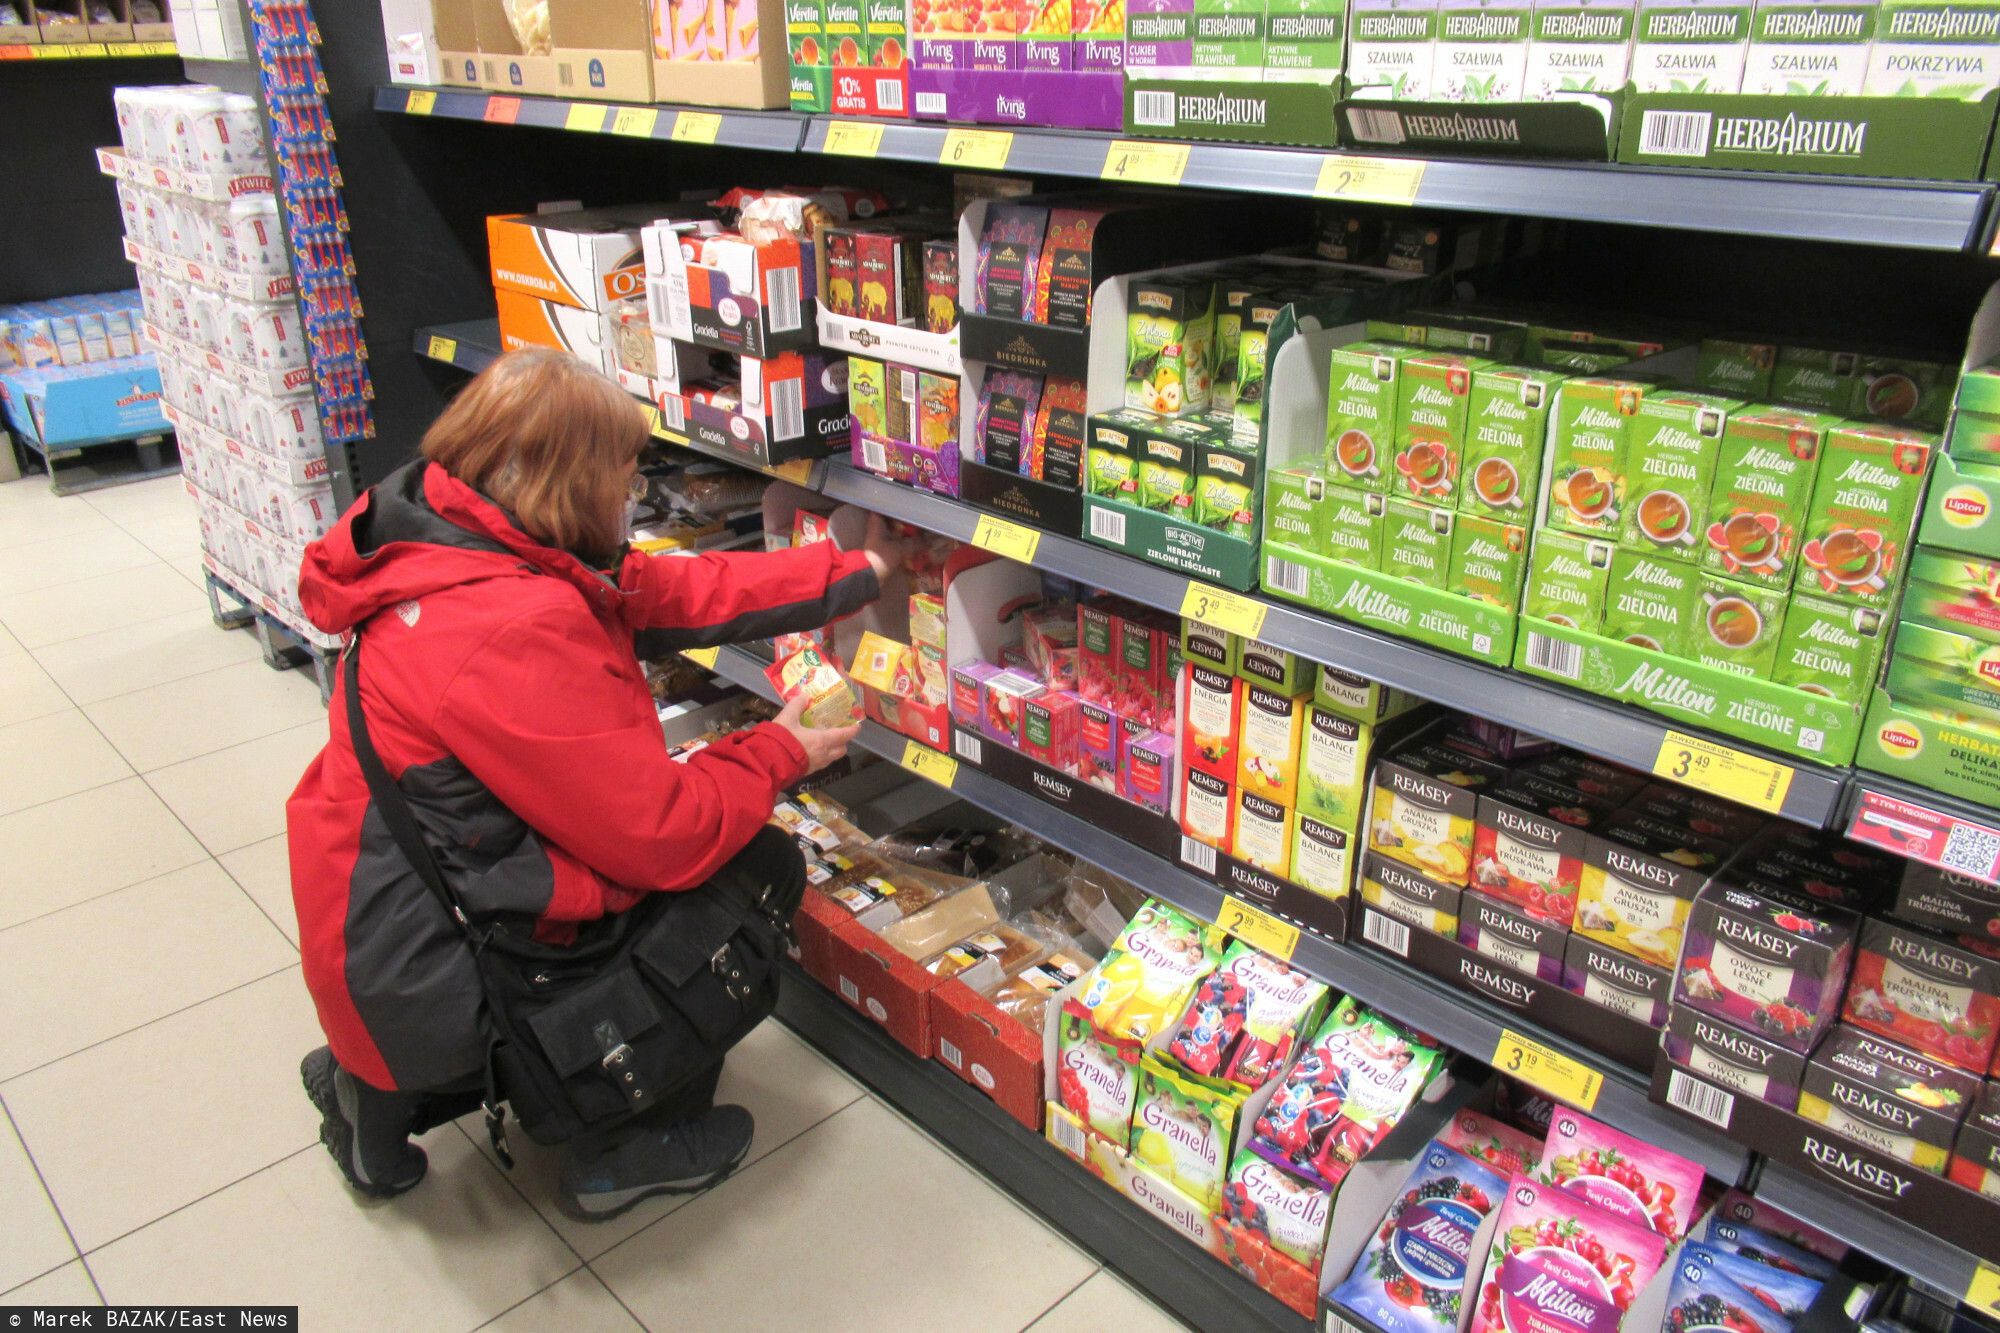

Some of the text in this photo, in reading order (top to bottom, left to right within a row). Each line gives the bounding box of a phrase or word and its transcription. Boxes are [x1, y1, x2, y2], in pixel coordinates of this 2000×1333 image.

[789, 7, 818, 22] Verdin
[827, 6, 858, 22] Verdin
[870, 5, 903, 22] Verdin
[1542, 11, 1622, 38] HERBARIUM
[1648, 11, 1737, 37] HERBARIUM
[1763, 9, 1863, 37] HERBARIUM
[1132, 15, 1185, 37] HERBARIUM
[1199, 14, 1255, 37] HERBARIUM
[1273, 14, 1333, 38] HERBARIUM
[1360, 14, 1426, 38] HERBARIUM
[1446, 12, 1519, 38] HERBARIUM
[1130, 46, 1156, 55] CUKIER
[1196, 55, 1235, 65] TRAWIENIE
[1268, 46, 1298, 55] AKTYWNE
[1268, 56, 1312, 67] TRAWIENIE
[1368, 51, 1413, 64] SZAŁWIA
[1453, 52, 1503, 66] SZAŁWIA
[1550, 52, 1603, 67] SZAŁWIA
[1656, 54, 1716, 69] SZAŁWIA
[1771, 55, 1838, 71] SZAŁWIA
[1887, 55, 1983, 73] POKRZYWA
[791, 78, 813, 92] Verdin
[839, 77, 860, 94] 10%
[837, 98, 866, 109] GRATIS
[1179, 92, 1266, 125] HERBARIUM
[1406, 113, 1519, 141] HERBARIUM
[1715, 112, 1867, 155] HERBARIUM
[1115, 154, 1127, 176] 4
[1335, 172, 1351, 194] 2
[997, 351, 1047, 368] BIEDRONKA
[1338, 401, 1377, 419] ZIELONA
[1411, 410, 1447, 427] ZIELONA
[1572, 406, 1622, 431] Milton
[1478, 426, 1523, 448] ZIELONA
[1572, 434, 1615, 451] ZIELONA
[1643, 457, 1697, 481] ZIELONA
[1735, 445, 1796, 475] Milton
[1834, 458, 1901, 490] Milton
[1734, 475, 1784, 497] ZIELONA
[994, 497, 1040, 518] BIEDRONKA
[1834, 490, 1889, 513] ZIELONA
[1948, 499, 1983, 514] Lipton
[1274, 516, 1310, 535] ZIELONA
[984, 532, 991, 547] 1
[1331, 531, 1369, 550] ZIELONA
[1148, 549, 1221, 578] ZIELONE LIŚCIASTE
[1166, 545, 1201, 561] HERBATY
[1393, 548, 1434, 570] ZIELONA
[1465, 563, 1501, 582] ZIELONA
[1624, 560, 1683, 591] Milton
[1335, 580, 1411, 625] Milton
[1540, 582, 1587, 606] ZIELONA
[1084, 610, 1109, 624] REMSEY
[1195, 597, 1220, 617] 3 49
[1617, 594, 1678, 624] ZIELONA
[1123, 623, 1149, 638] REMSEY
[1419, 612, 1469, 640] ZIELONE
[1799, 619, 1861, 649] Milton
[1191, 640, 1222, 659] REMSEY
[1248, 659, 1280, 678] REMSEY
[1791, 649, 1852, 678] ZIELONA
[1195, 670, 1228, 693] REMSEY
[1615, 662, 1717, 715] Milton
[1194, 689, 1227, 706] ENERGIA
[1252, 691, 1288, 712] REMSEY
[1325, 682, 1366, 704] BALANCE
[1026, 703, 1050, 719] REMSEY
[1083, 706, 1109, 722] REMSEY
[1249, 709, 1289, 729] ODPORNOŚĆ
[1726, 701, 1795, 735] ZIELONE
[1316, 714, 1353, 735] REMSEY
[1312, 734, 1353, 755] BALANCE
[1884, 732, 1915, 747] Lipton
[911, 754, 920, 768] 4
[1132, 747, 1159, 763] REMSEY
[1672, 751, 1692, 777] 3
[1695, 755, 1710, 768] 49
[1951, 748, 2000, 770] DELIKA
[1033, 772, 1072, 798] REMSEY
[1192, 772, 1224, 792] REMSEY
[1394, 773, 1453, 805] REMSEY
[1190, 791, 1223, 809] ENERGIA
[1245, 796, 1280, 817] REMSEY
[1404, 807, 1438, 825] ANANAS
[1880, 800, 1896, 810] TYM
[1897, 806, 1941, 823] TYGODNIU
[1304, 821, 1341, 844] REMSEY
[1401, 814, 1438, 835] GRUSZKA
[1497, 810, 1562, 844] REMSEY
[1301, 840, 1342, 862] BALANCE
[1510, 845, 1545, 864] MALINA
[1499, 851, 1554, 876] TRUSKAWKA
[1606, 851, 1680, 887] REMSEY
[1232, 866, 1280, 897] REMSEY
[1381, 867, 1437, 901] REMSEY
[1391, 900, 1422, 918] ANANAS
[1613, 897, 1660, 919] GRUSZKA
[1617, 889, 1660, 909] ANANAS
[1229, 912, 1254, 933] 2 99
[1480, 908, 1542, 944] REMSEY
[1717, 916, 1798, 959] REMSEY
[1492, 942, 1524, 960] OWOCE
[1889, 936, 1981, 979] REMSEY
[1587, 953, 1656, 990] REMSEY
[1730, 957, 1773, 980] OWOCE
[1230, 956, 1309, 1005] Granella
[1460, 958, 1536, 1004] REMSEY
[1900, 976, 1951, 1001] MALINA
[1600, 988, 1636, 1010] OWOCE
[1695, 1022, 1774, 1065] REMSEY
[1324, 1033, 1406, 1093] Granella
[1507, 1047, 1538, 1071] 3 19
[1857, 1040, 1943, 1078] REMSEY
[1065, 1050, 1127, 1107] Granella
[1708, 1061, 1749, 1085] OWOCE
[1831, 1081, 1922, 1129] REMSEY
[1143, 1102, 1216, 1166] Granella
[1559, 1121, 1576, 1136] 40
[1842, 1122, 1894, 1149] ANANAS
[1803, 1136, 1913, 1197] REMSEY
[1241, 1162, 1324, 1228] Granella
[1517, 1190, 1534, 1205] 40
[1131, 1174, 1205, 1239] Granella
[1719, 1226, 1736, 1240] 40
[1685, 1266, 1701, 1282] 40
[1514, 1273, 1596, 1324] Milton
